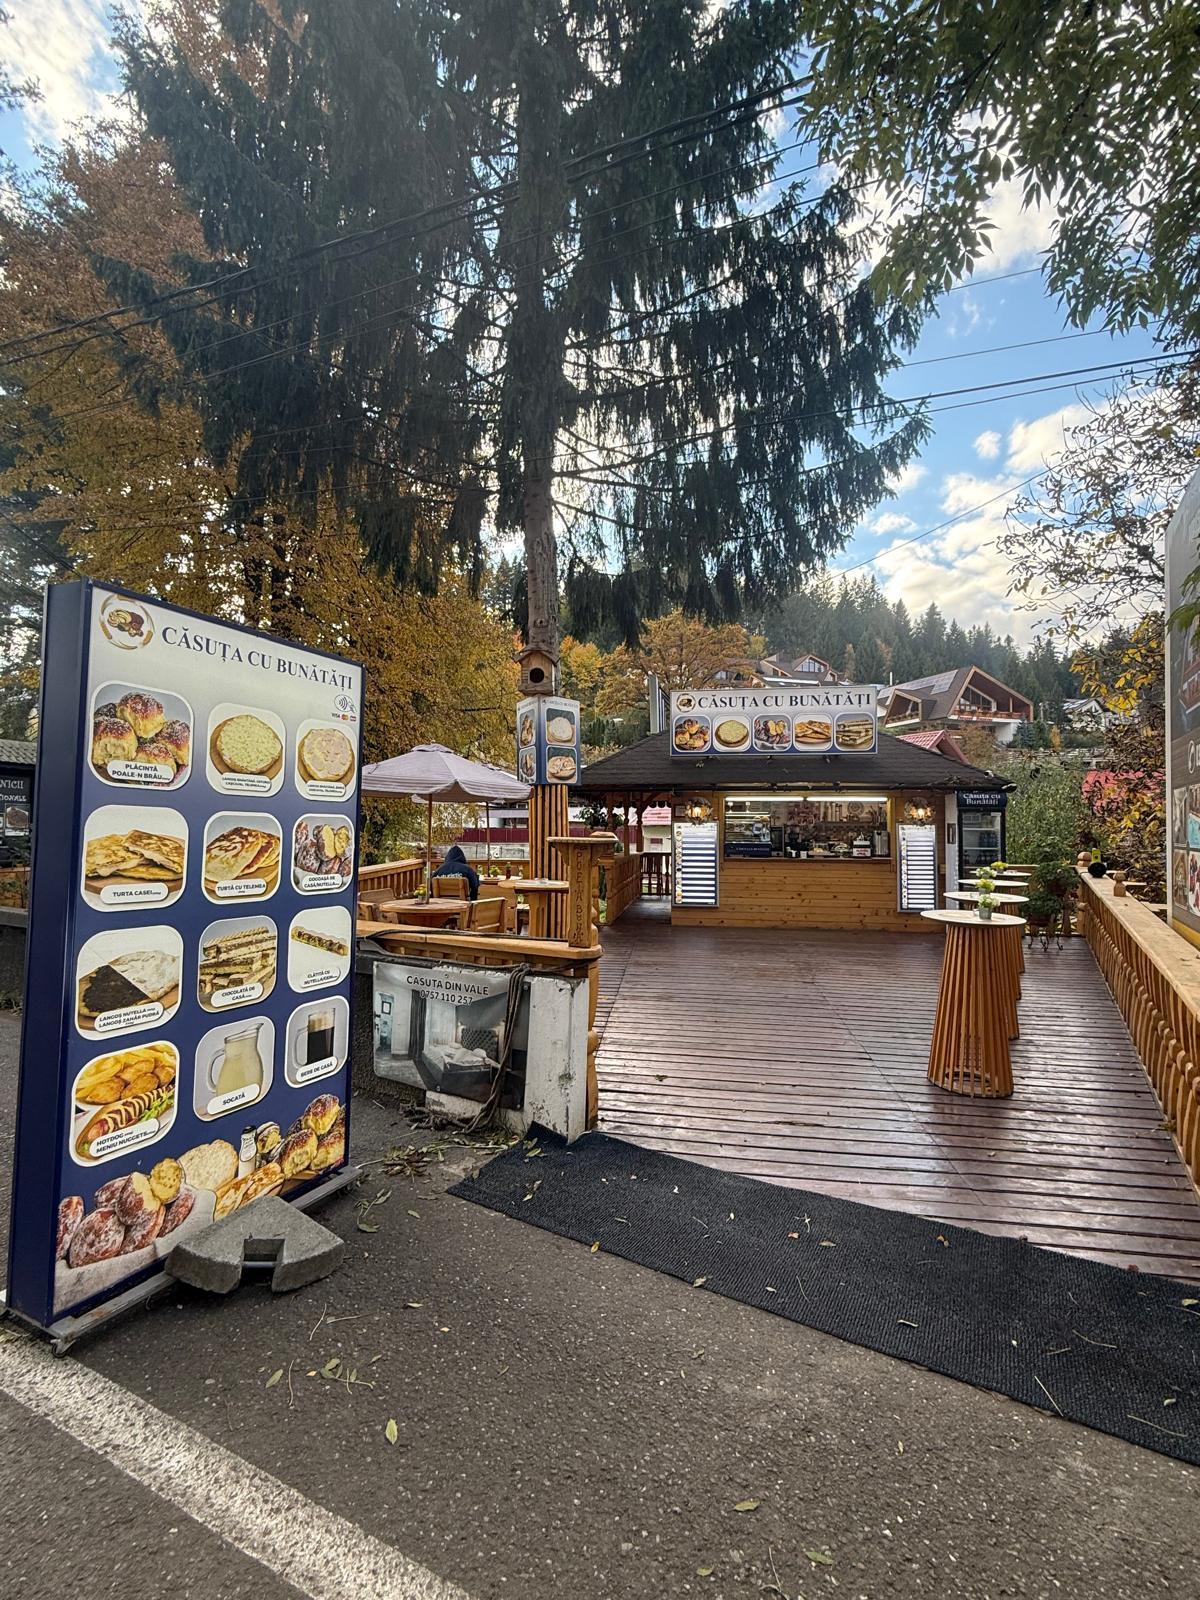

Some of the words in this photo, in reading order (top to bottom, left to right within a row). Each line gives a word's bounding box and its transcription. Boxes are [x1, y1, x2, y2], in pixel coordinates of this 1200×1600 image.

[162, 626, 243, 663] CĂSUȚA
[247, 651, 272, 669] CU
[277, 658, 352, 691] BUNĂTĂȚI
[699, 694, 759, 711] CĂSUȚA
[762, 695, 784, 708] CU
[789, 691, 871, 708] BUNĂTĂȚI
[406, 975, 443, 988] CASUTA
[445, 981, 462, 991] DIN
[464, 984, 489, 996] VALE
[420, 989, 439, 1000] 0757
[441, 992, 455, 1003] 110
[457, 995, 473, 1005] 257
